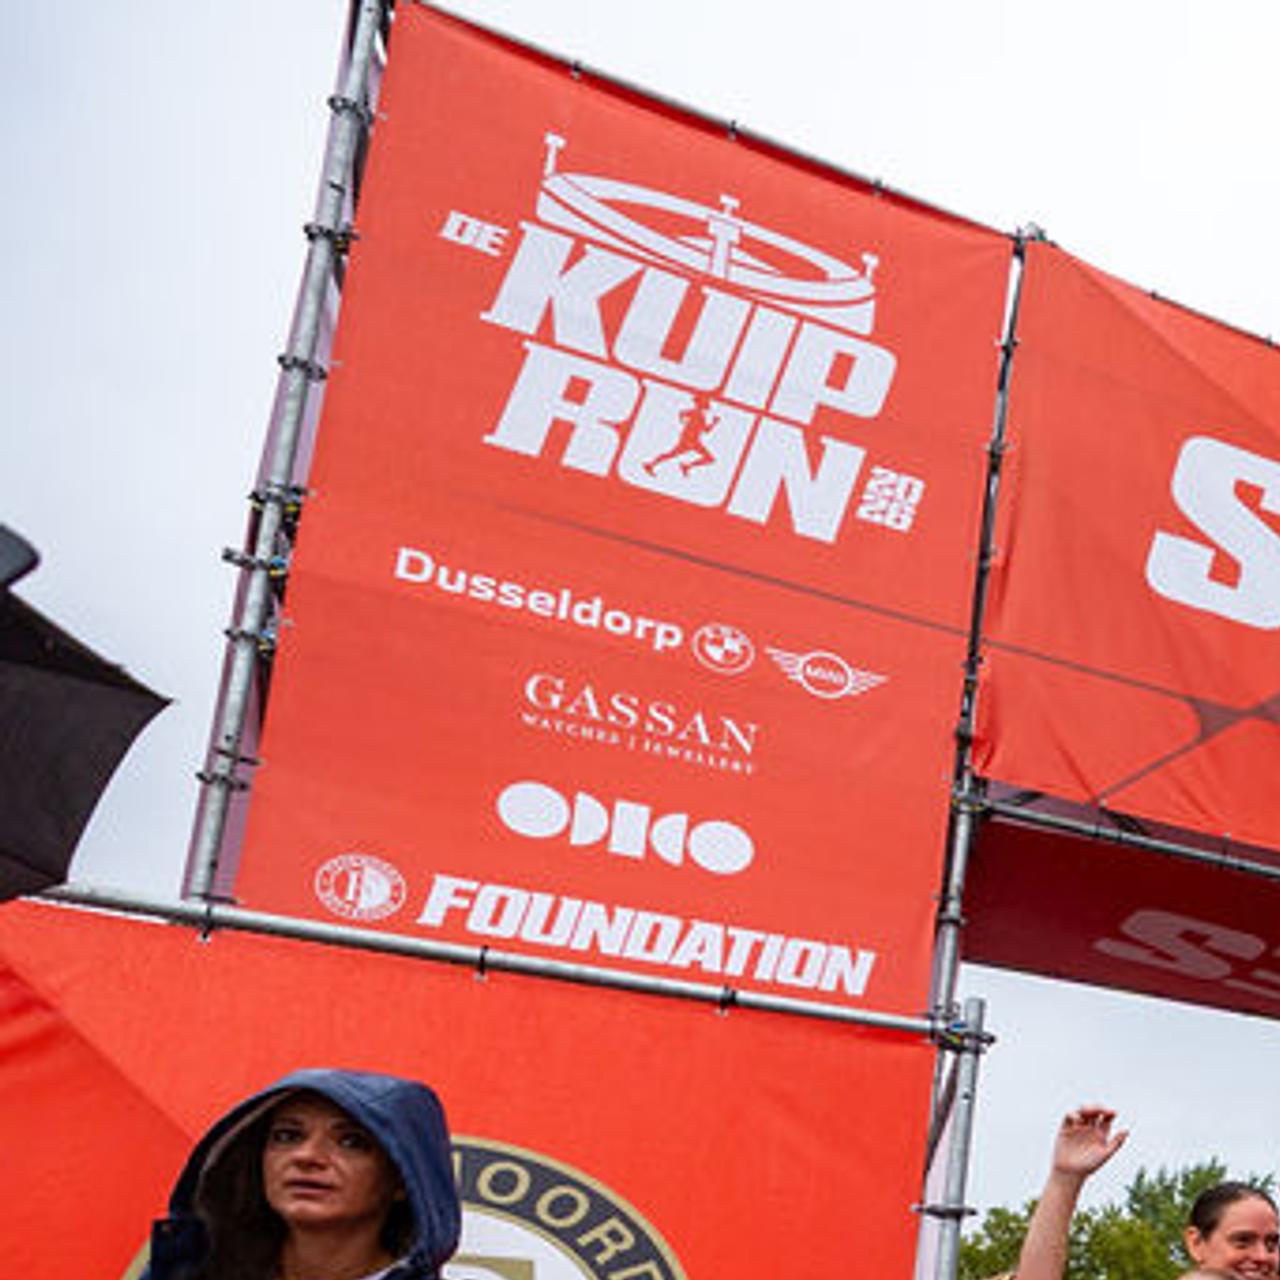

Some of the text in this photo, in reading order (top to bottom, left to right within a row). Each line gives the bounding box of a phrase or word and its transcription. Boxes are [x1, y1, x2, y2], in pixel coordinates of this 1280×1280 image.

[440, 210, 510, 257] DE
[480, 220, 897, 424] KUIP
[483, 340, 866, 543] RUN
[394, 546, 684, 651] Dusseldorp
[525, 673, 758, 756] GASSAN
[416, 874, 876, 997] FOUNDATION
